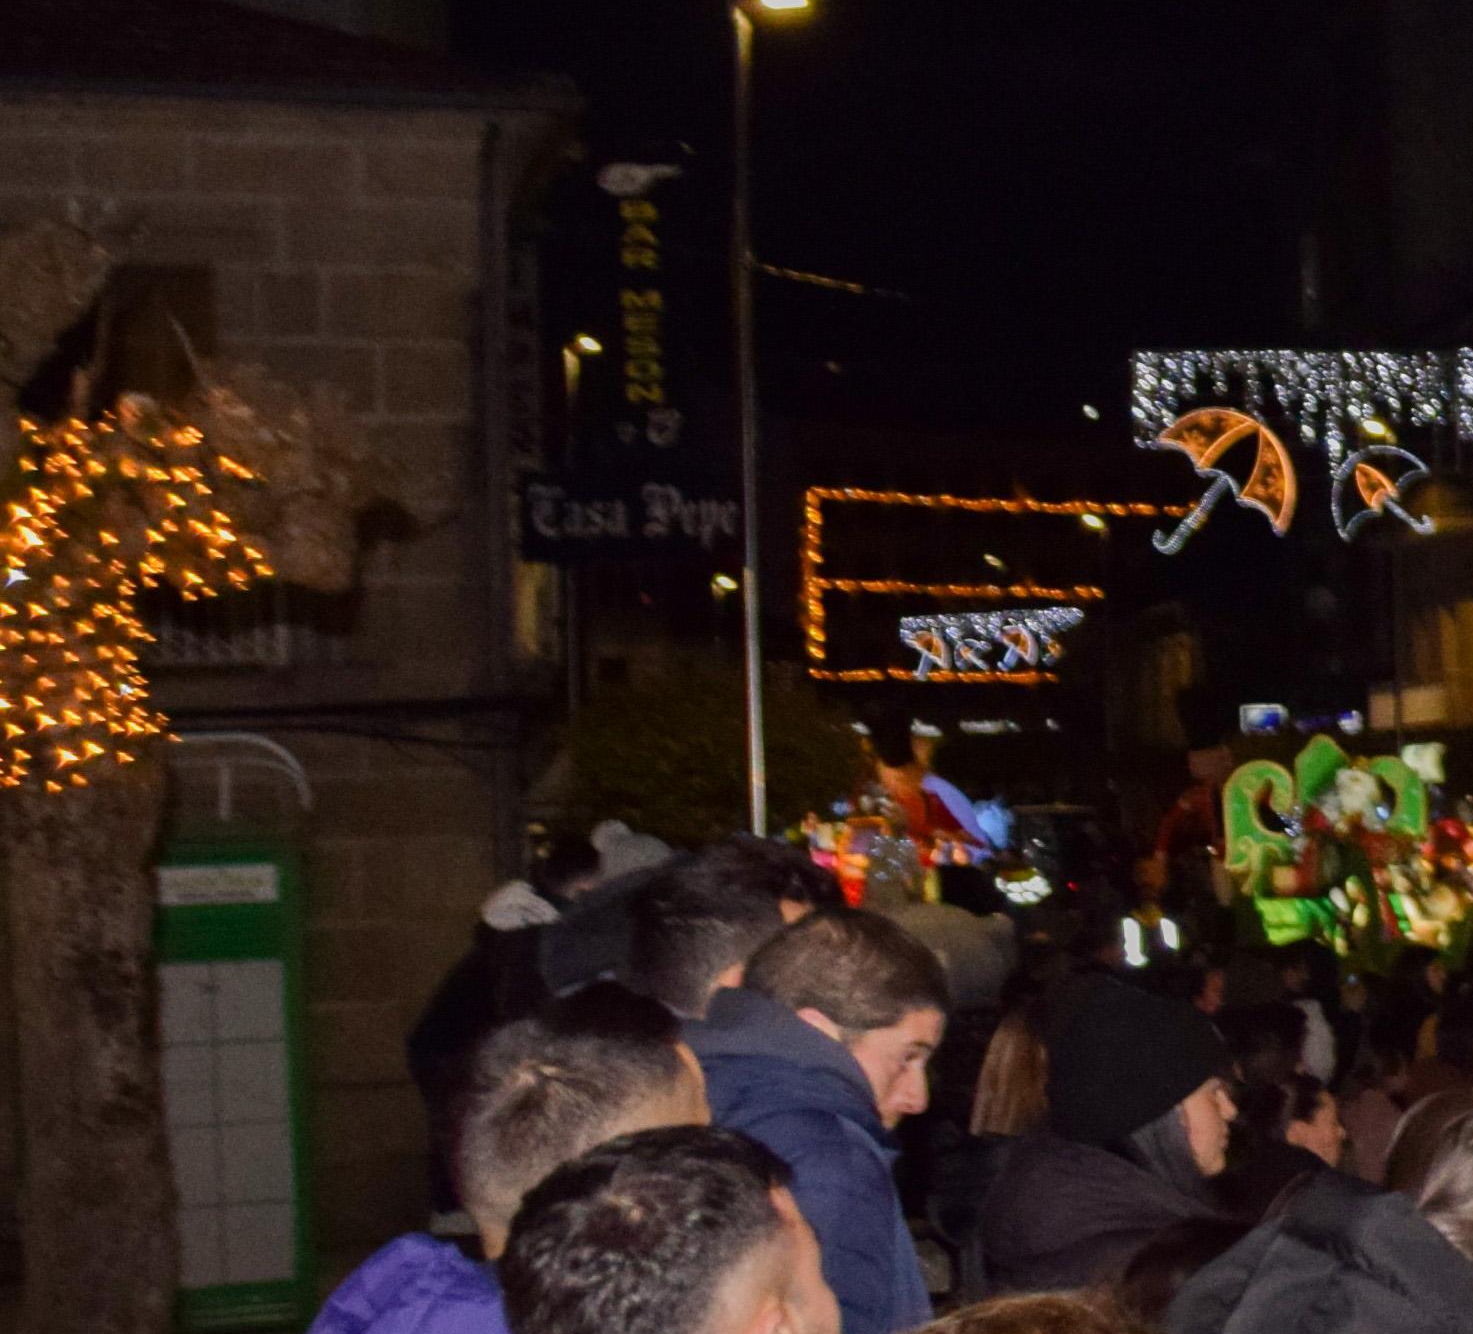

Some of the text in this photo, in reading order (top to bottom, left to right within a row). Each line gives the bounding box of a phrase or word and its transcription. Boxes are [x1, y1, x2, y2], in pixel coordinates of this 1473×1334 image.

[619, 199, 659, 268] BAR
[527, 481, 740, 548] Casa Pepe
